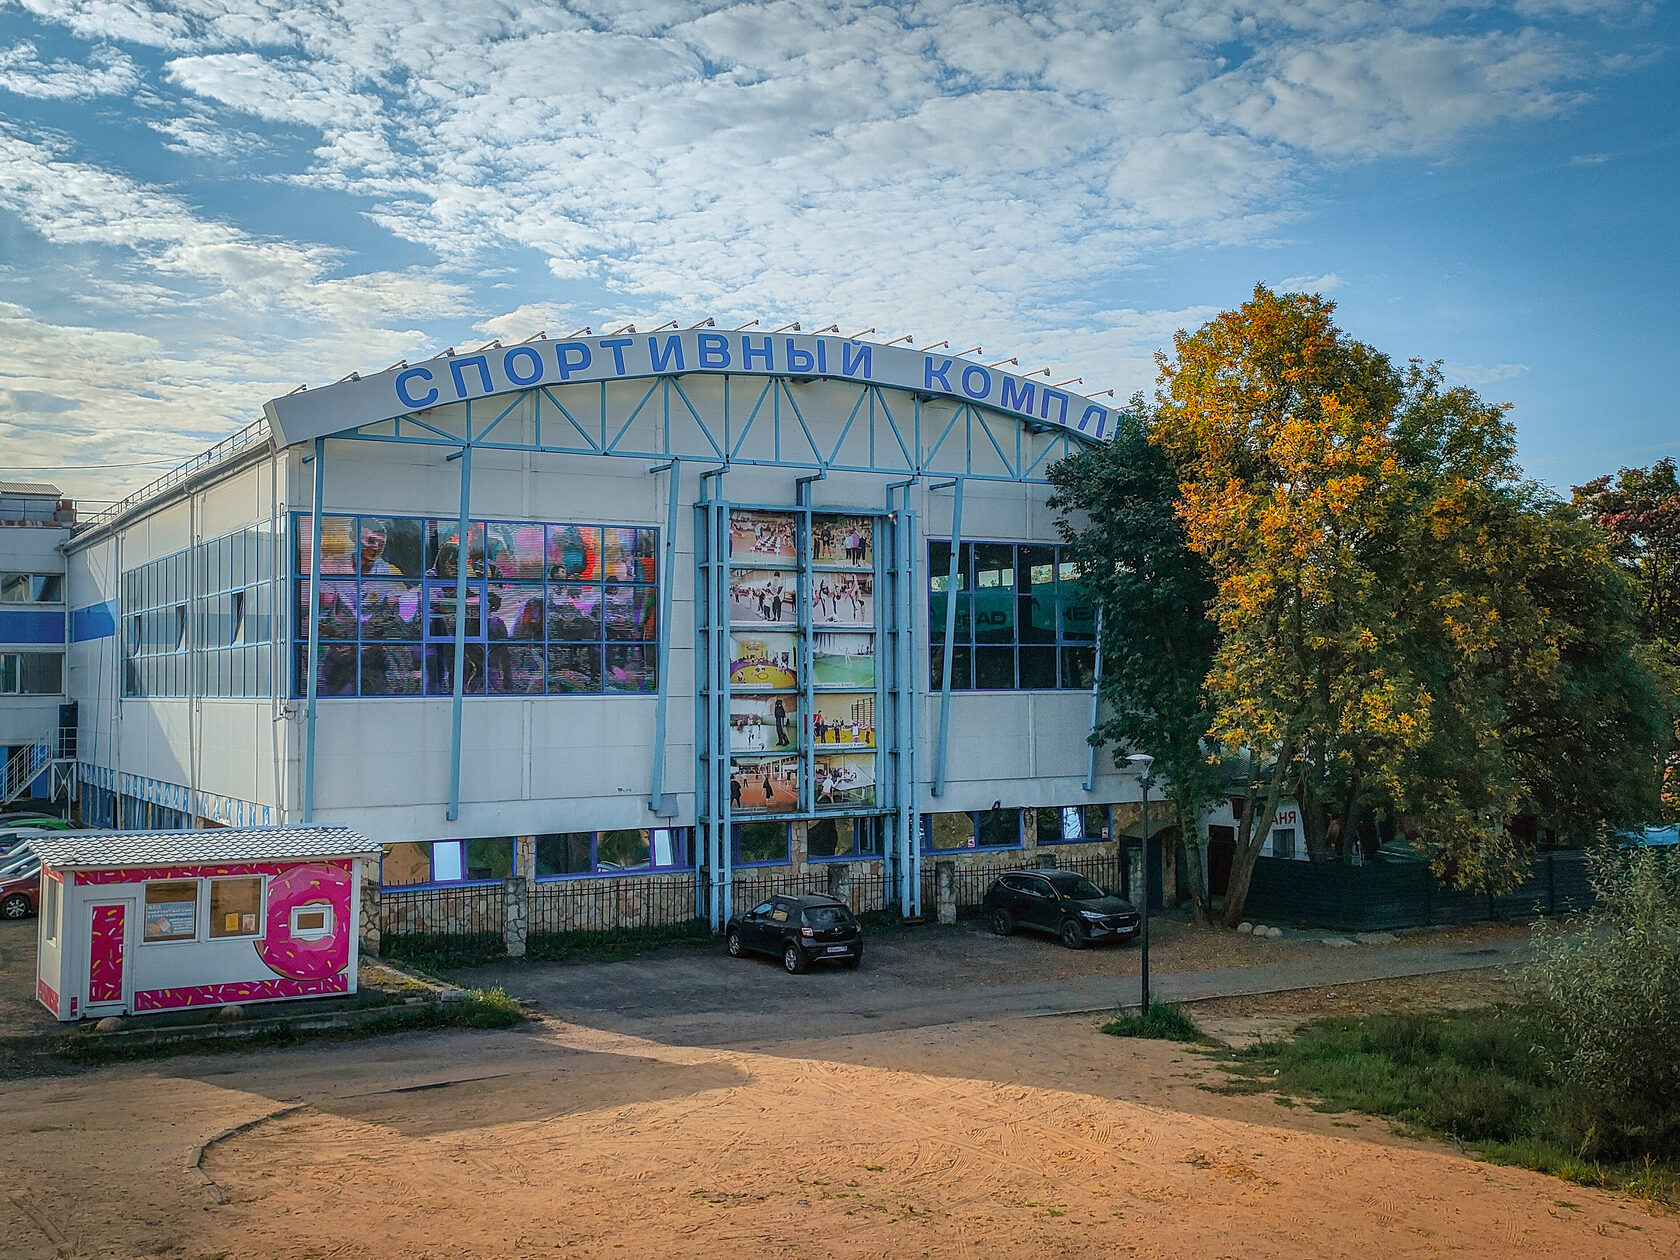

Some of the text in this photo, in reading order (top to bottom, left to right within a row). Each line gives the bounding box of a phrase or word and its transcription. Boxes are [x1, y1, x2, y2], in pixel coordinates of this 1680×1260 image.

[396, 333, 1120, 442] СПОРТИВНЫЙ КОМПЛ
[1271, 811, 1297, 825] АНЯ
